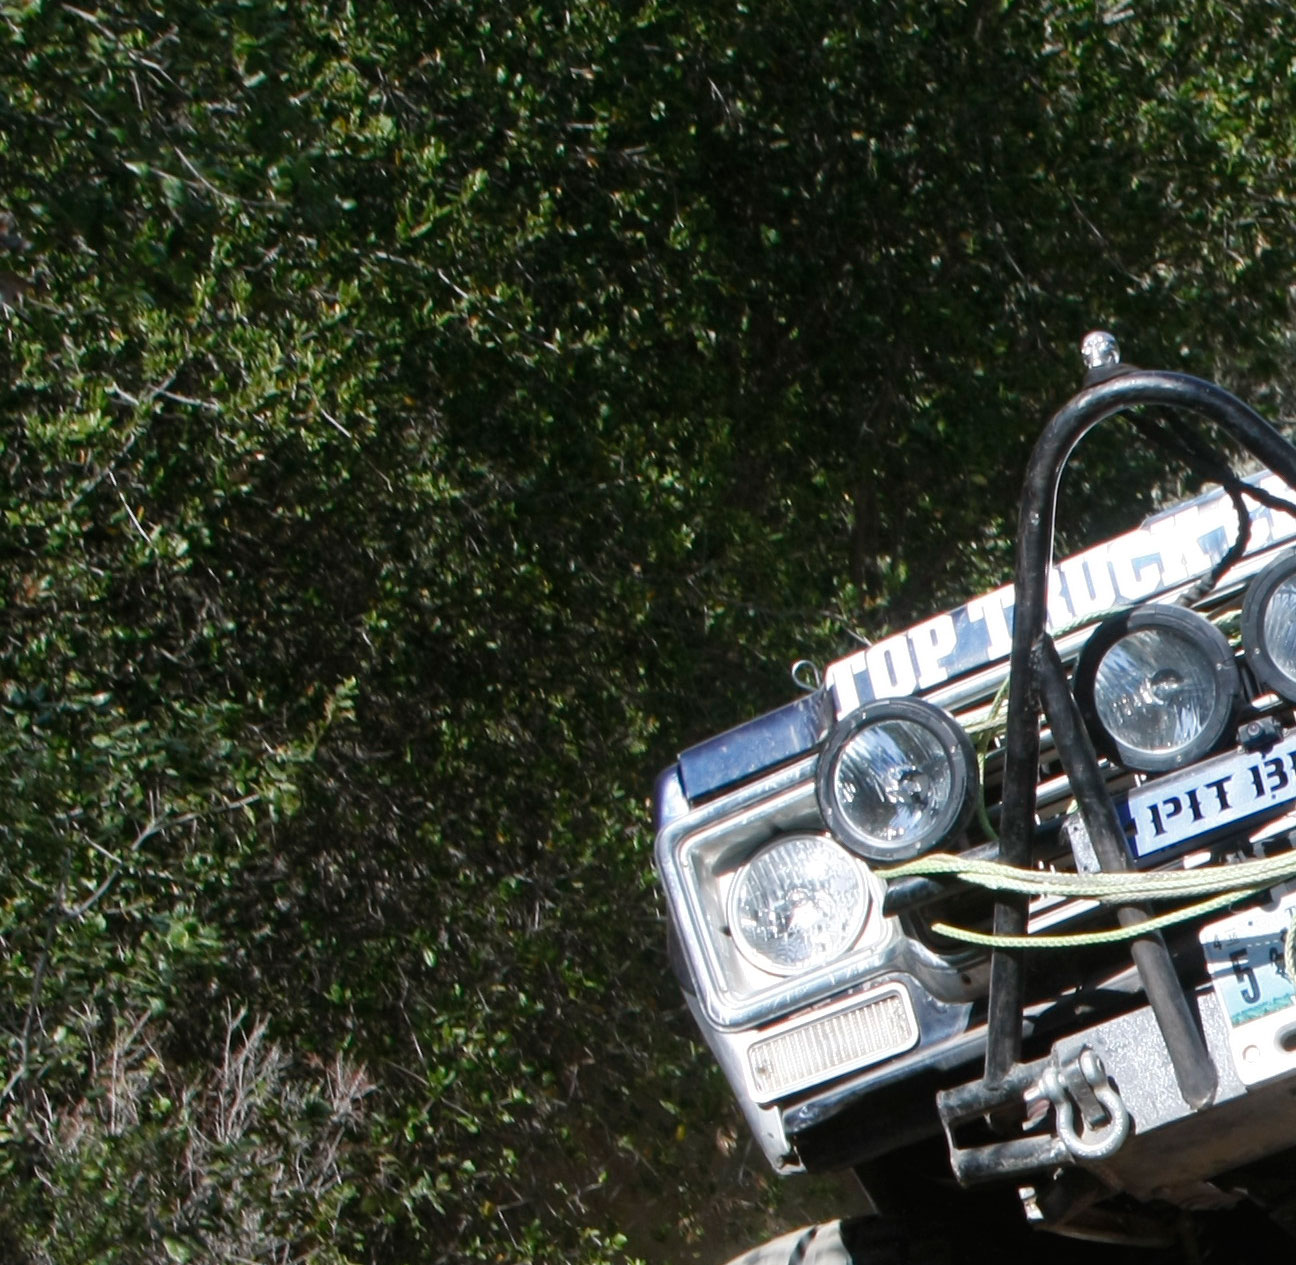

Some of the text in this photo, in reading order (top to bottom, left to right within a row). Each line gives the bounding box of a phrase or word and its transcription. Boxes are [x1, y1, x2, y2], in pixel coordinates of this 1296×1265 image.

[827, 614, 959, 721] TOP
[1147, 775, 1232, 836] PIT
[1230, 948, 1260, 1004] 5
